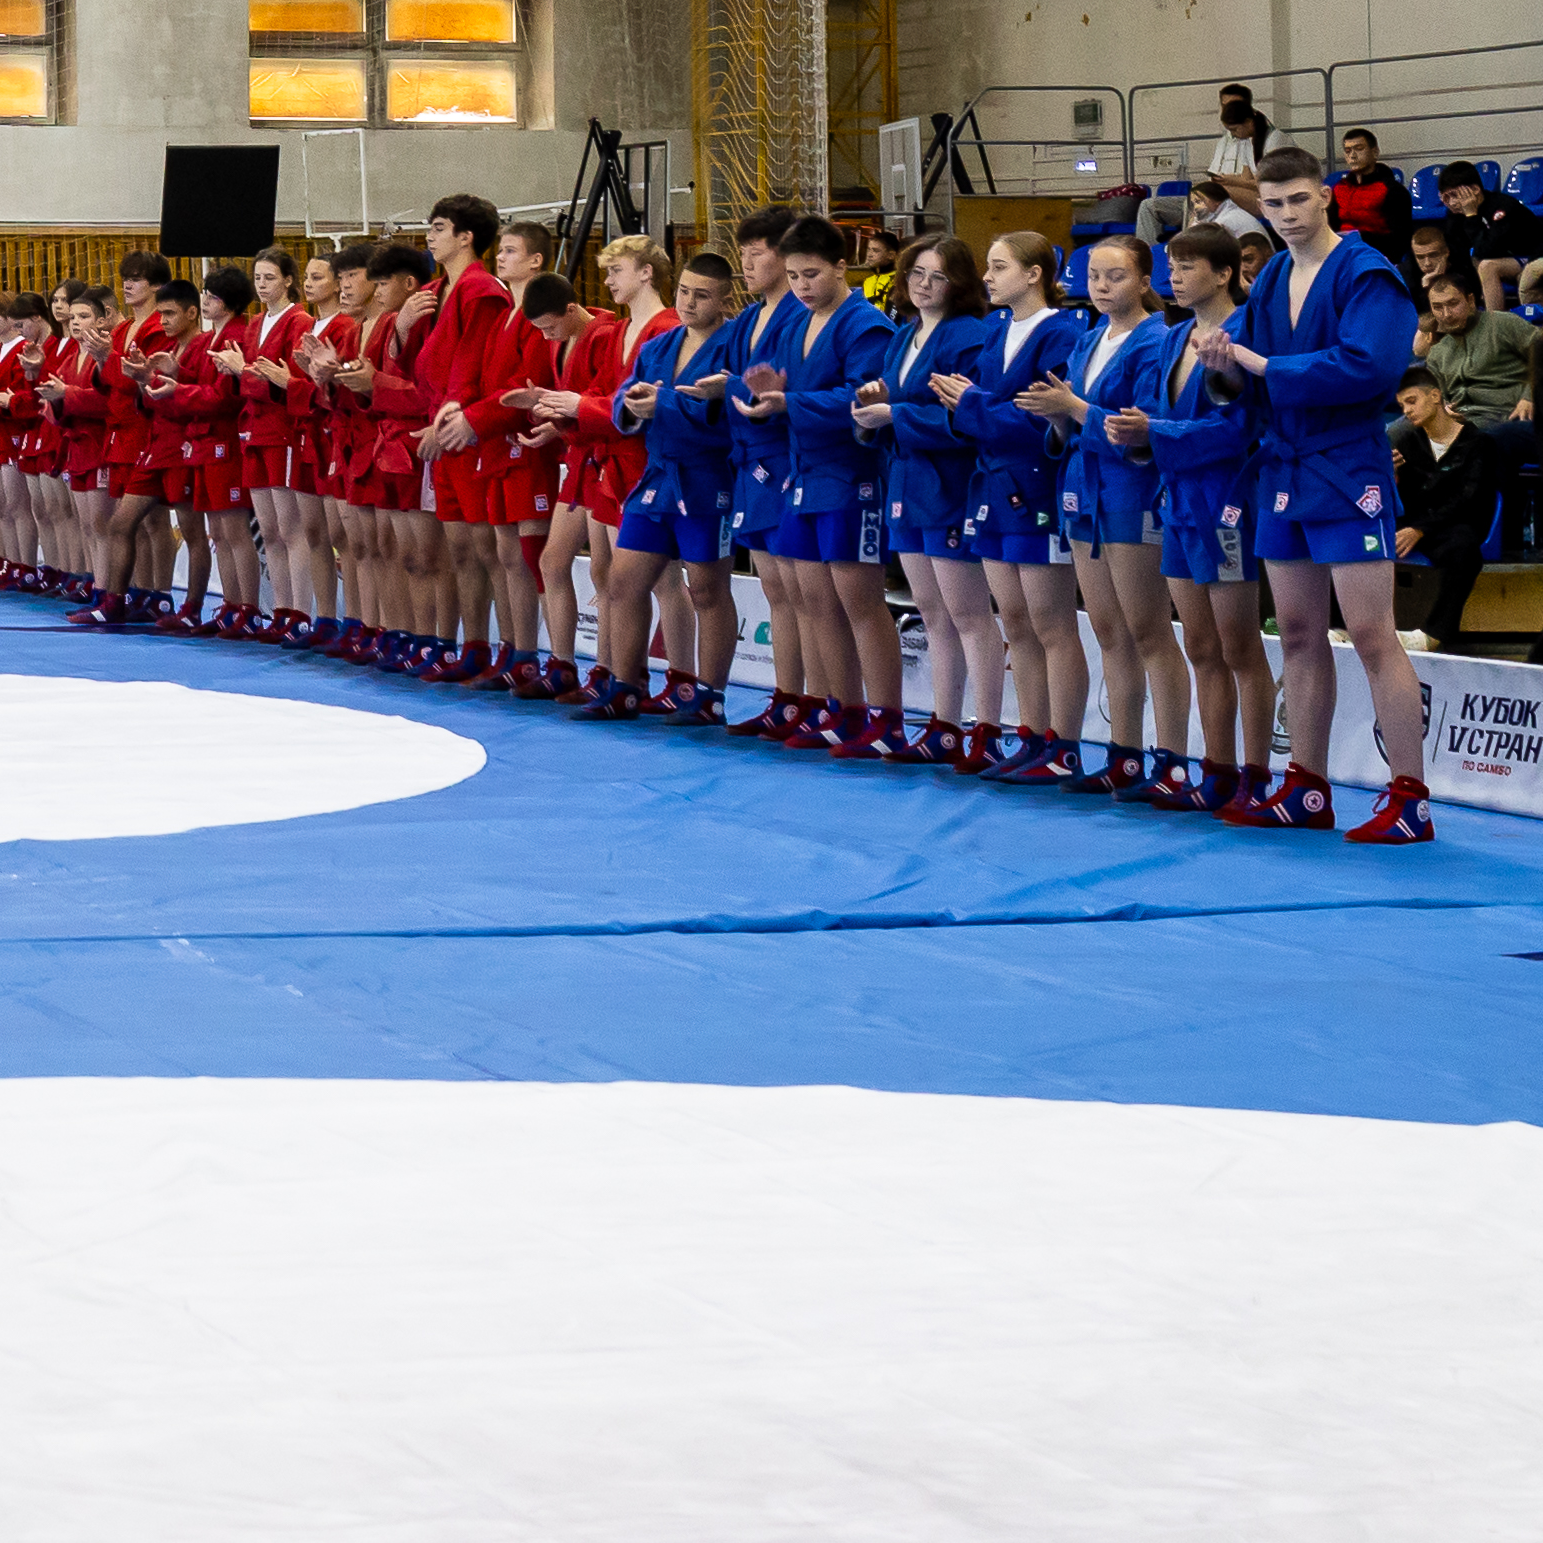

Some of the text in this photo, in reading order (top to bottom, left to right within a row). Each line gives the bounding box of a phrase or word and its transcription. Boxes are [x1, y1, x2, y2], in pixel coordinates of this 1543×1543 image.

[1461, 693, 1542, 729] КУБОК
[1462, 760, 1512, 777] ПО САМБО
